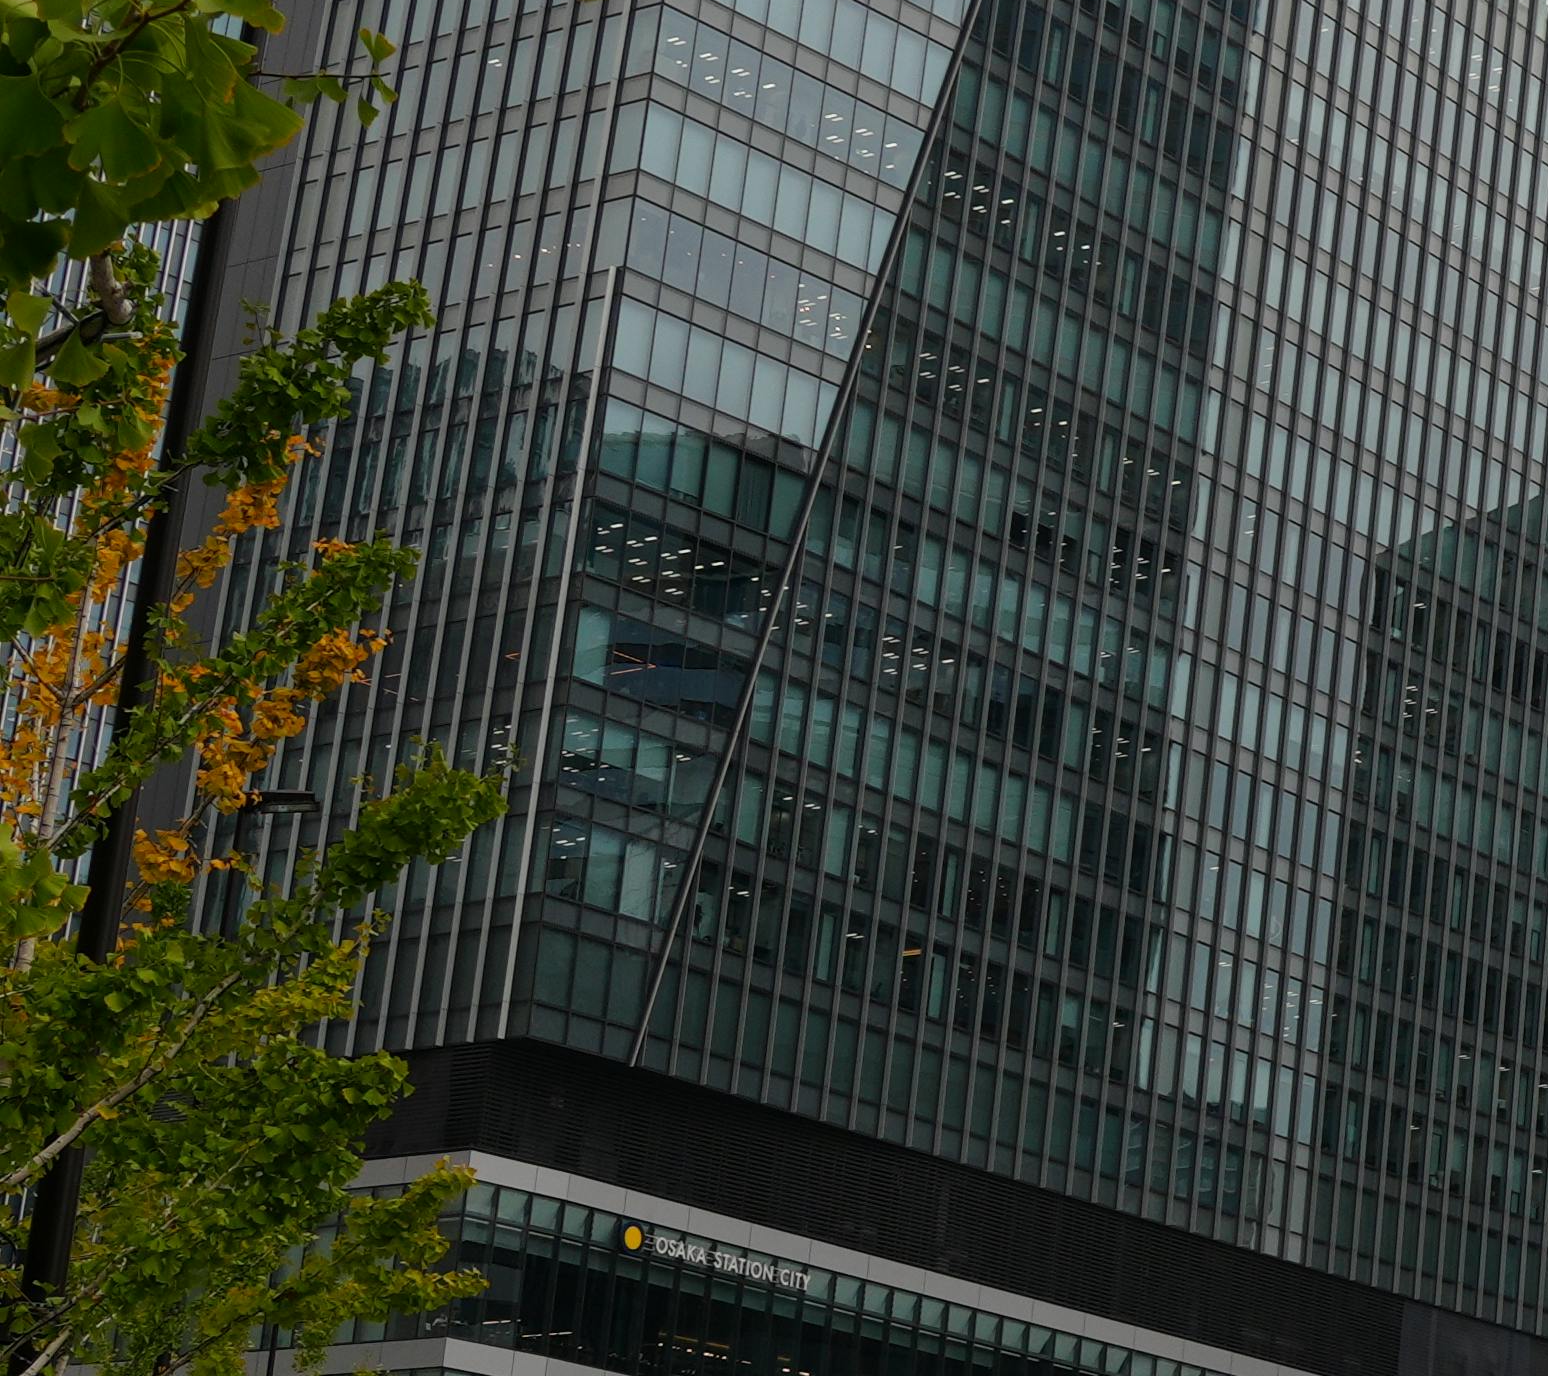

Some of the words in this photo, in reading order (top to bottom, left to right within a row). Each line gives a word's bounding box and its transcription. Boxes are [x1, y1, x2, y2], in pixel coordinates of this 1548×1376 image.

[656, 1237, 707, 1265] OSAKA
[713, 1251, 774, 1282] STATION
[780, 1269, 811, 1291] CITY
